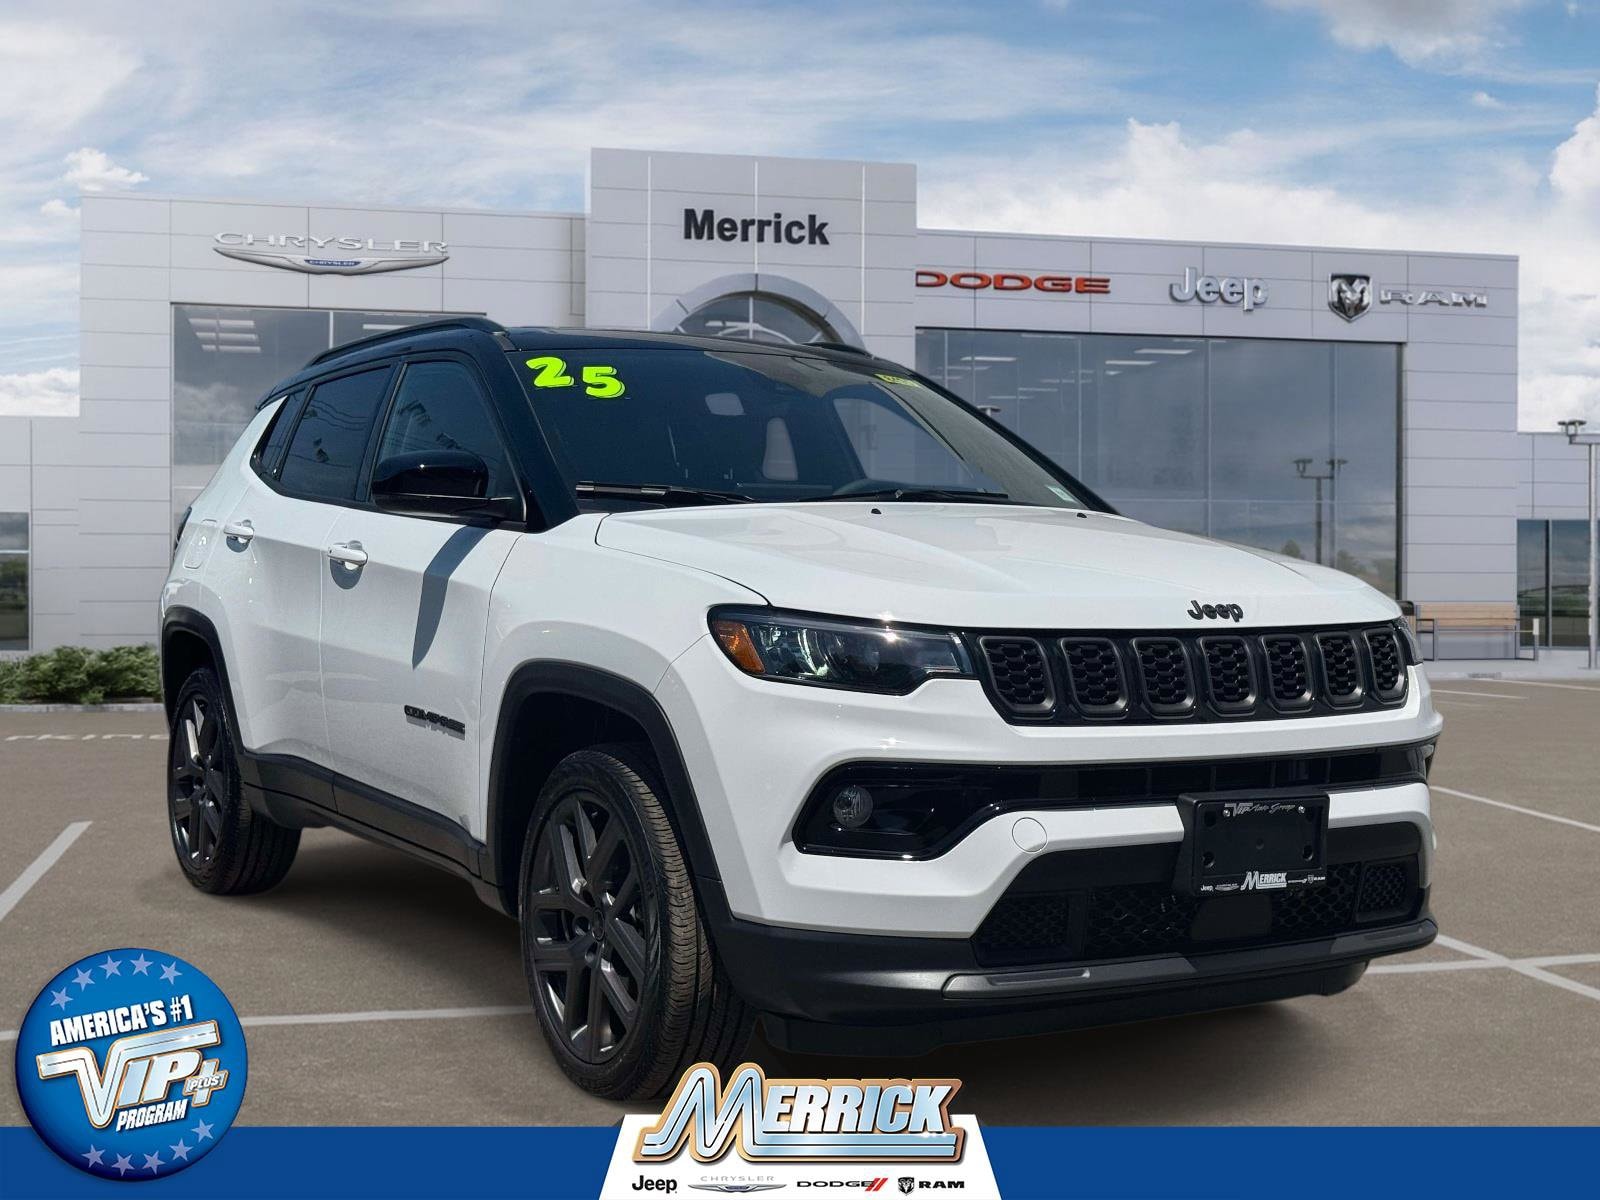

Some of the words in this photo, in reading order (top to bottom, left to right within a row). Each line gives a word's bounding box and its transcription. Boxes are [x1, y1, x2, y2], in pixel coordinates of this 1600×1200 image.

[683, 208, 830, 246] Merrick
[214, 232, 449, 253] CHRYSLER
[915, 271, 1111, 294] DODGE
[1169, 266, 1268, 312] Jeep
[1379, 289, 1488, 308] RAM
[1187, 599, 1244, 622] Jeep
[1240, 871, 1287, 891] MERRICK
